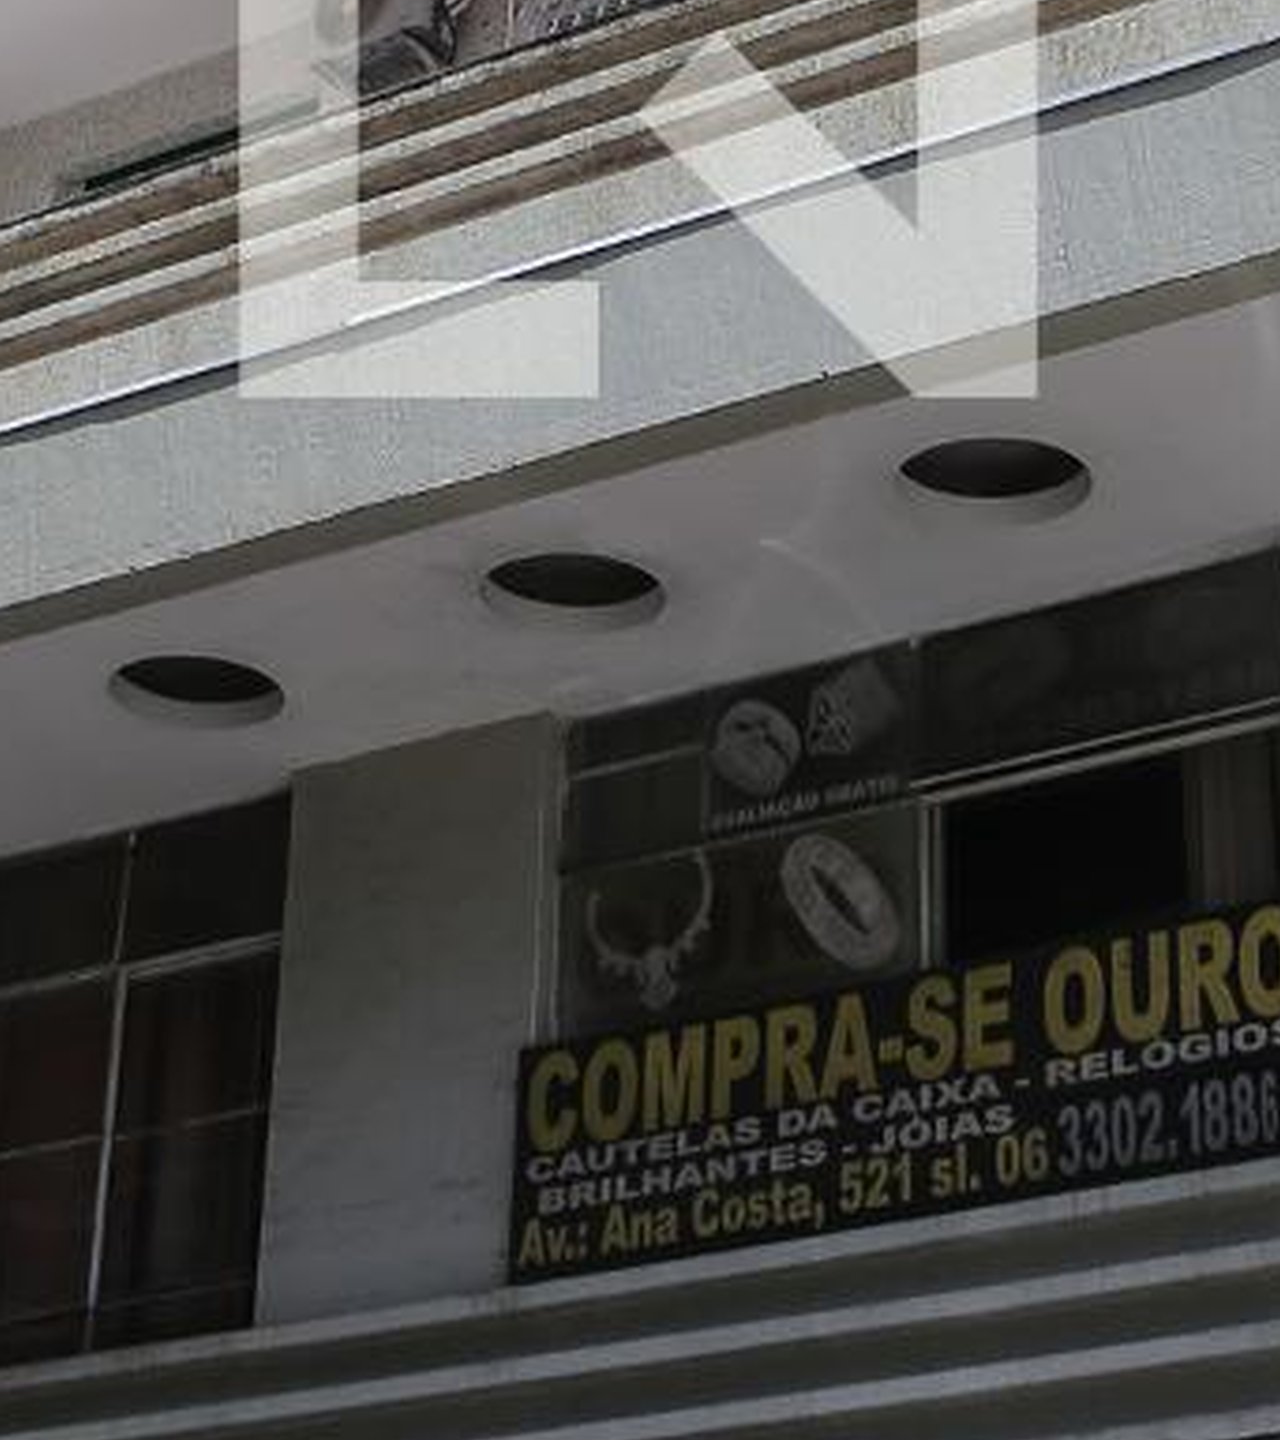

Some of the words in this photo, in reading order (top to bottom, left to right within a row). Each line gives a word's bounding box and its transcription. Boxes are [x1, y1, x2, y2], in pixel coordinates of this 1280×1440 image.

[527, 961, 1014, 1153] COMPRA-SE
[526, 1117, 761, 1183] CAUTELAS
[778, 1105, 837, 1138] DA
[853, 1075, 1001, 1123] CAIXA
[537, 1138, 827, 1214] BRILHANTES
[601, 1205, 677, 1256] Ana
[693, 1180, 825, 1238] Costa,
[838, 1152, 913, 1213] 521
[995, 1127, 1049, 1184] 06
